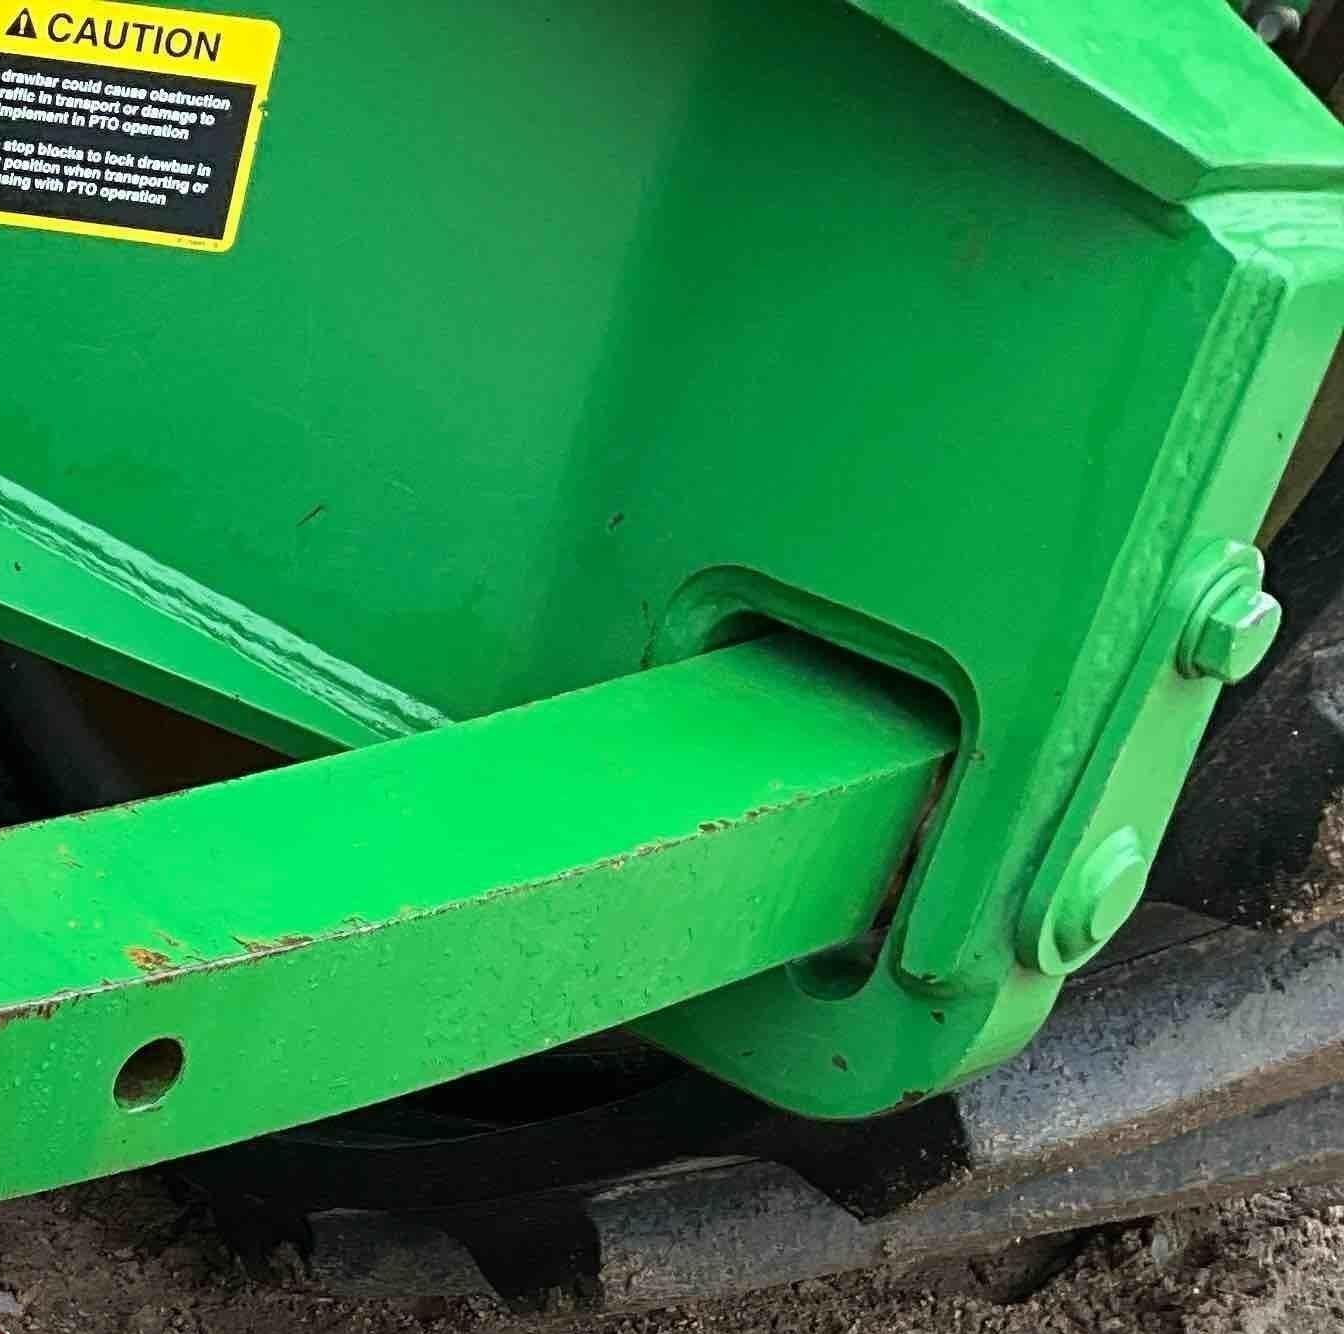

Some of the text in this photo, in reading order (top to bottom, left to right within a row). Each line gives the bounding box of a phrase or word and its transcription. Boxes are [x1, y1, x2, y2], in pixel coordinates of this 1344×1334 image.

[47, 12, 222, 62] CAUTION
[1, 69, 60, 89] drawbar
[61, 78, 103, 94] could
[103, 84, 148, 100] cause
[149, 88, 231, 110] obstruction
[38, 90, 53, 105] in
[55, 93, 121, 114] transport
[122, 103, 140, 116] or
[140, 104, 198, 126] damage
[199, 111, 215, 126] to
[71, 111, 86, 127] in
[88, 114, 120, 131] PTO
[121, 121, 190, 140] operation
[2, 139, 35, 157] stop
[37, 142, 85, 161] blocks
[86, 148, 103, 163] to
[104, 150, 135, 168] lock
[137, 155, 196, 175] drawbar
[196, 162, 212, 177] in
[2, 158, 61, 175] position
[63, 163, 102, 181] when
[103, 168, 190, 195] transporting
[192, 181, 209, 194] or
[34, 176, 65, 193] with
[66, 180, 98, 197] PTO
[99, 186, 167, 206] operation
